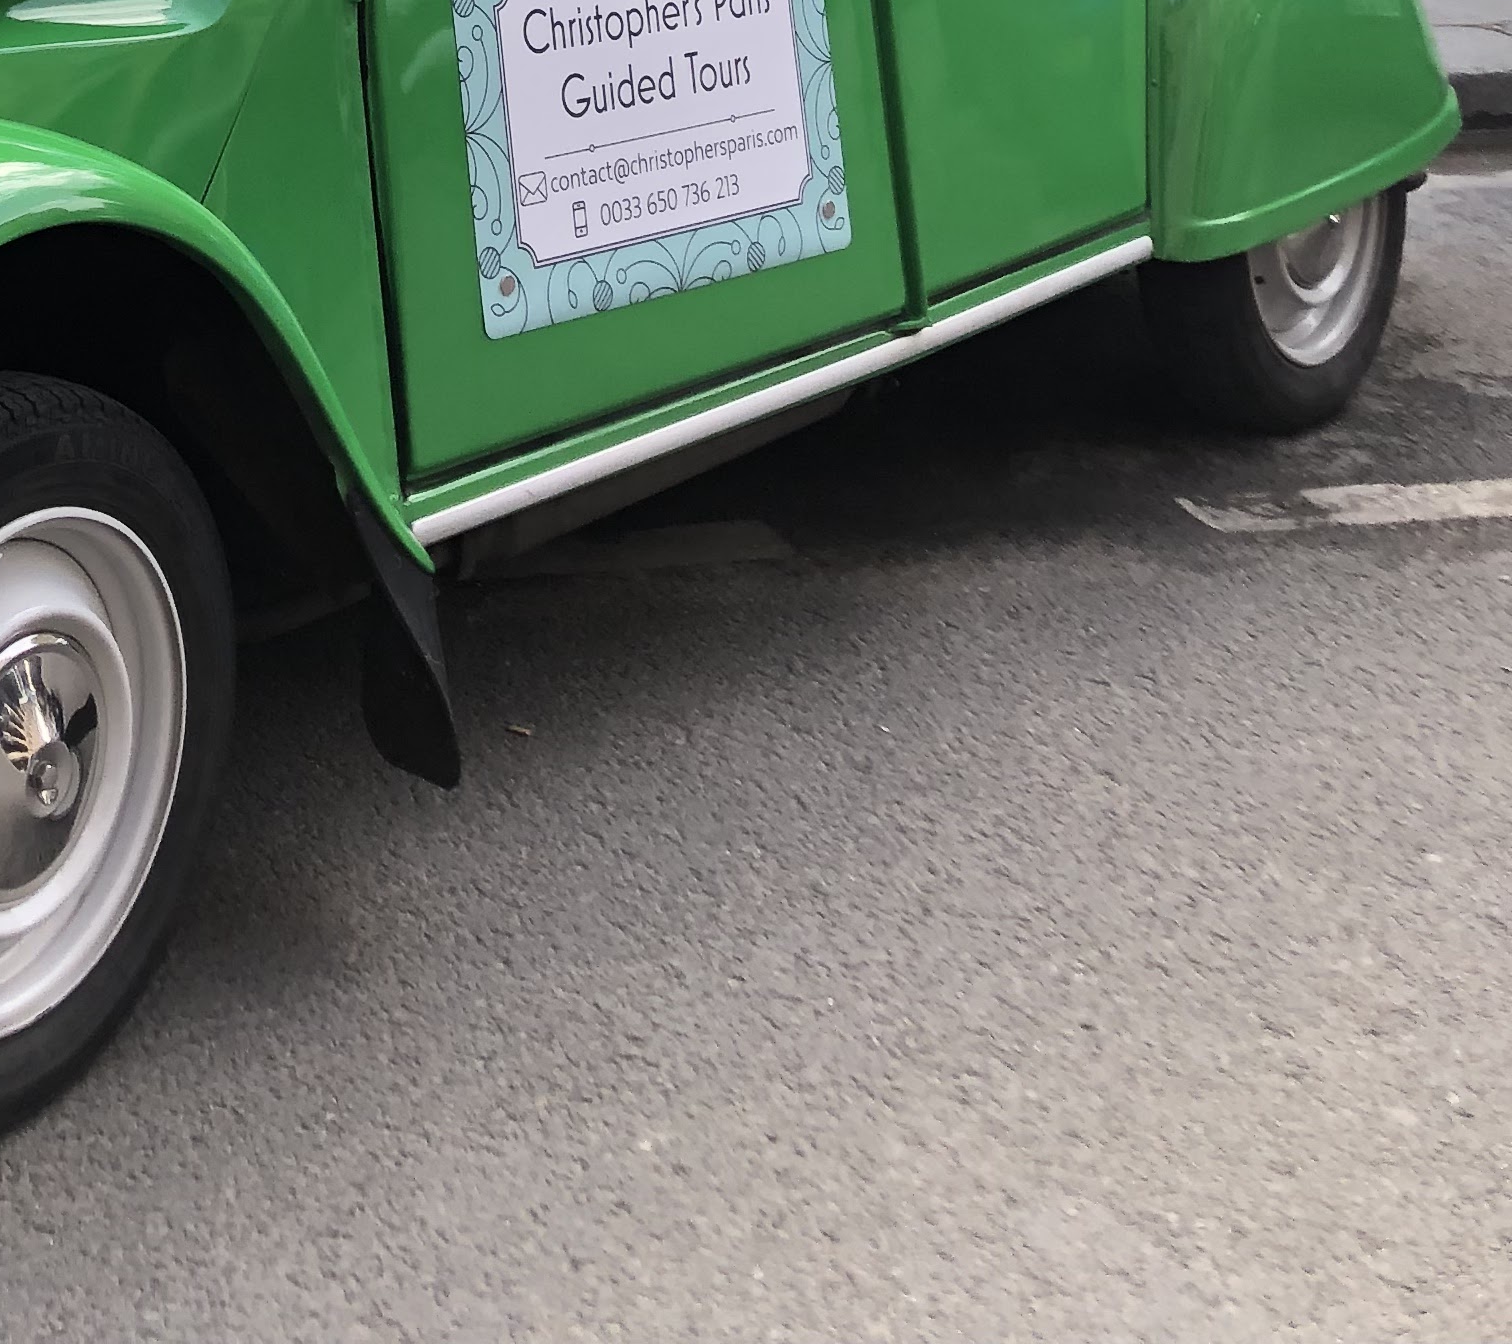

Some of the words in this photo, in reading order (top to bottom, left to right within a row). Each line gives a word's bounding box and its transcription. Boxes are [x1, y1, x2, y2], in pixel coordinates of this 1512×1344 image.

[561, 56, 676, 118] Guided
[684, 51, 751, 94] Tours
[550, 122, 800, 194] contact@christophersparis.com
[598, 195, 643, 228] 0033
[645, 188, 679, 217] 650
[681, 180, 712, 209] 736
[715, 173, 741, 200] 213
